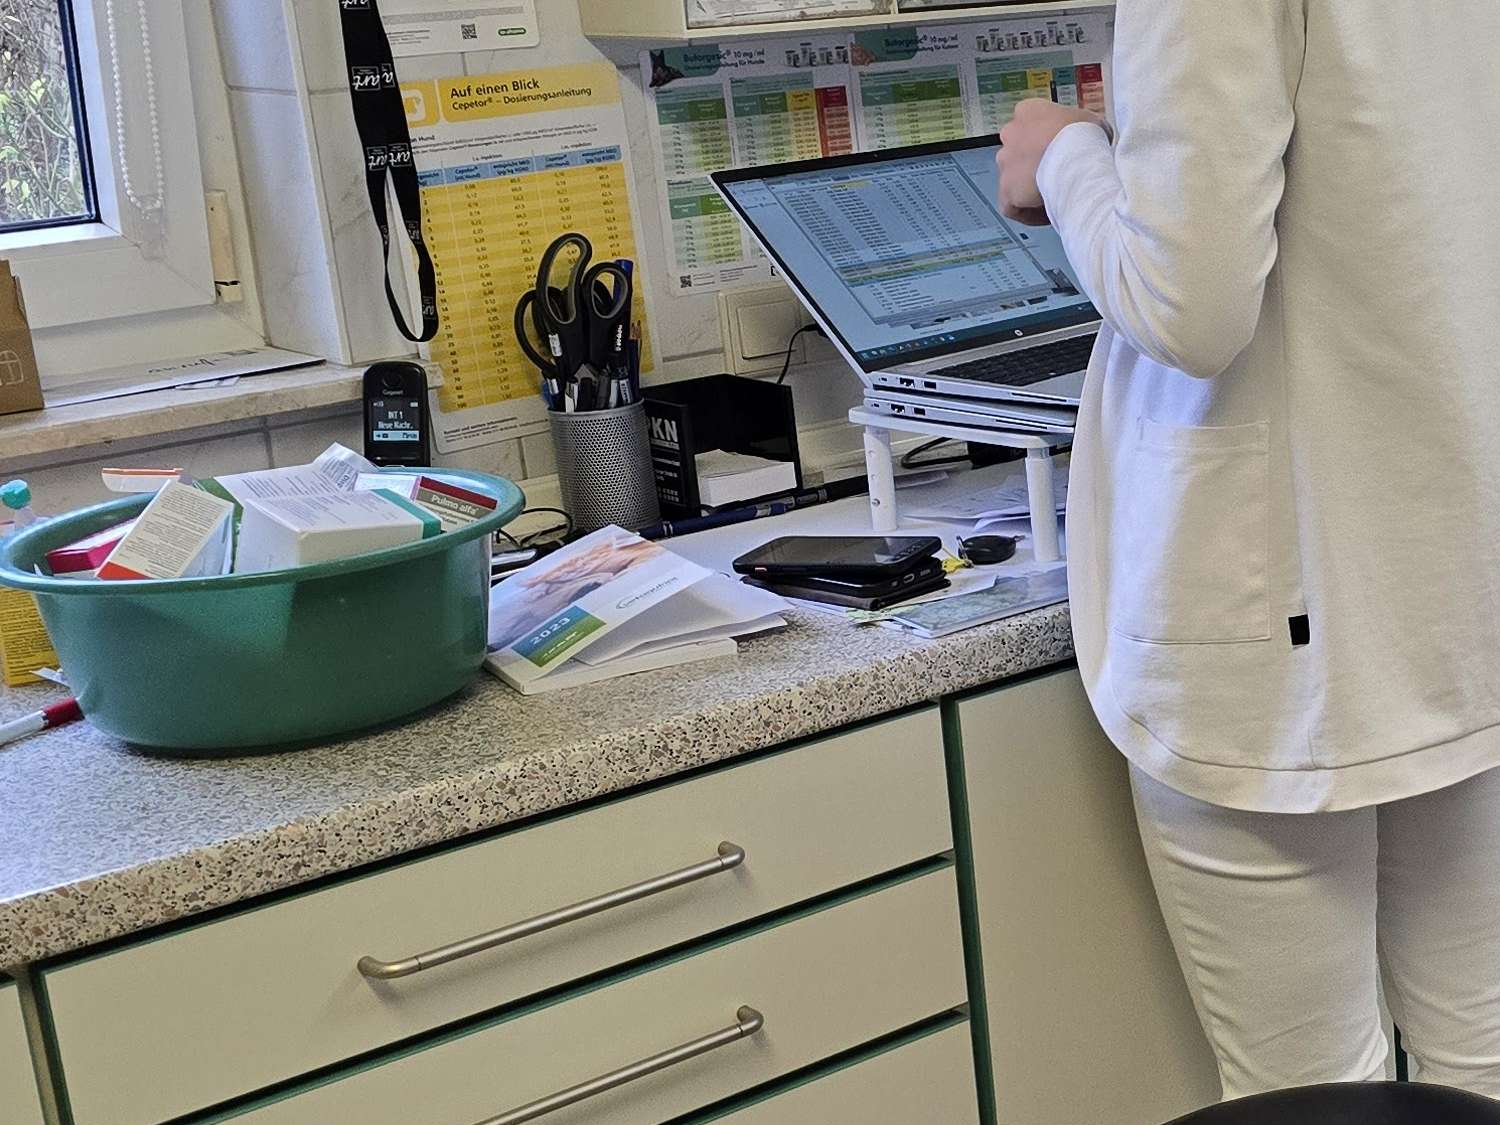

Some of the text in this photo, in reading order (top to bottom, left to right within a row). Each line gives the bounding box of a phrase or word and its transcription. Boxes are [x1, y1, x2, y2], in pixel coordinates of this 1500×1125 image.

[450, 78, 540, 99] Auf einen Blick
[503, 87, 592, 105] Dosierungsanleitung
[650, 416, 679, 442] KN
[530, 616, 571, 645] 2023
